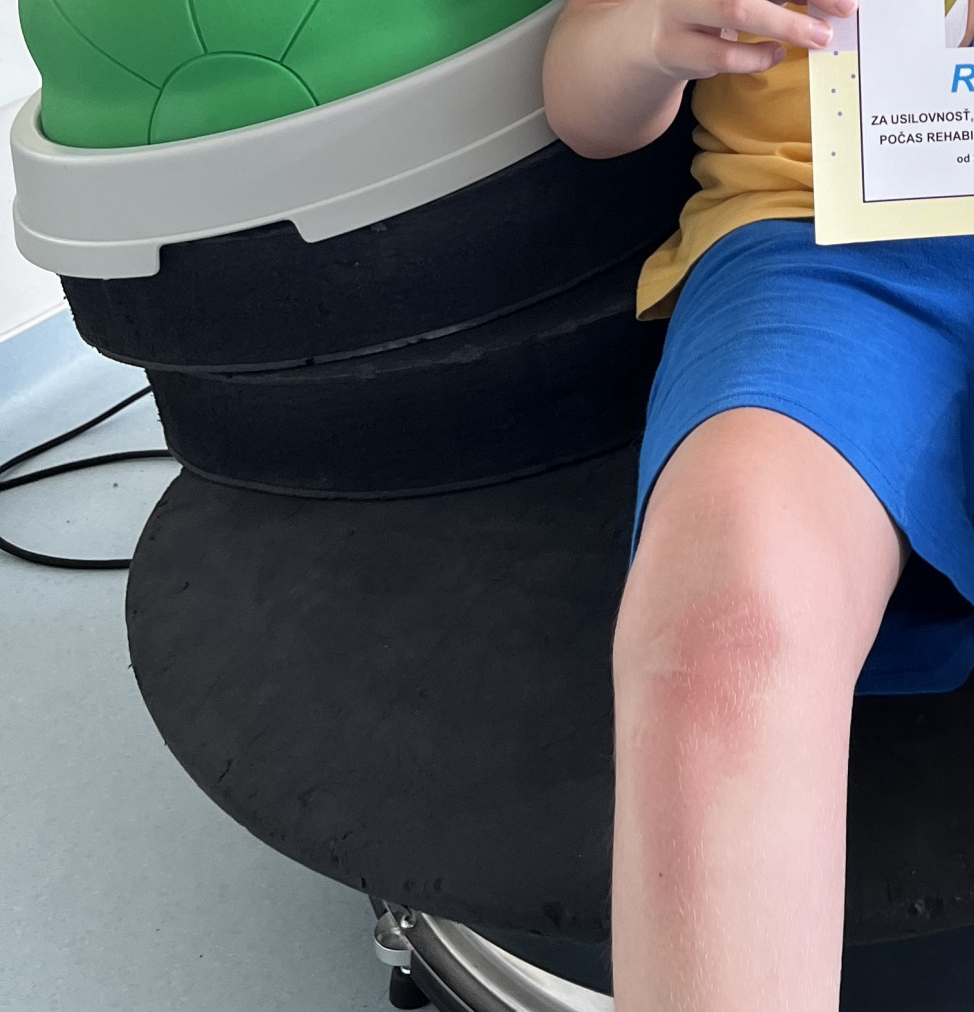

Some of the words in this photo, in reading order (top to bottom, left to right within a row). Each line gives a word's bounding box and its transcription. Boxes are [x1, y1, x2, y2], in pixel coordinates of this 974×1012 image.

[871, 115, 888, 126] ZA
[891, 108, 974, 125] USILOVNOSŤ,
[879, 131, 923, 145] POČAS
[956, 154, 970, 163] od
